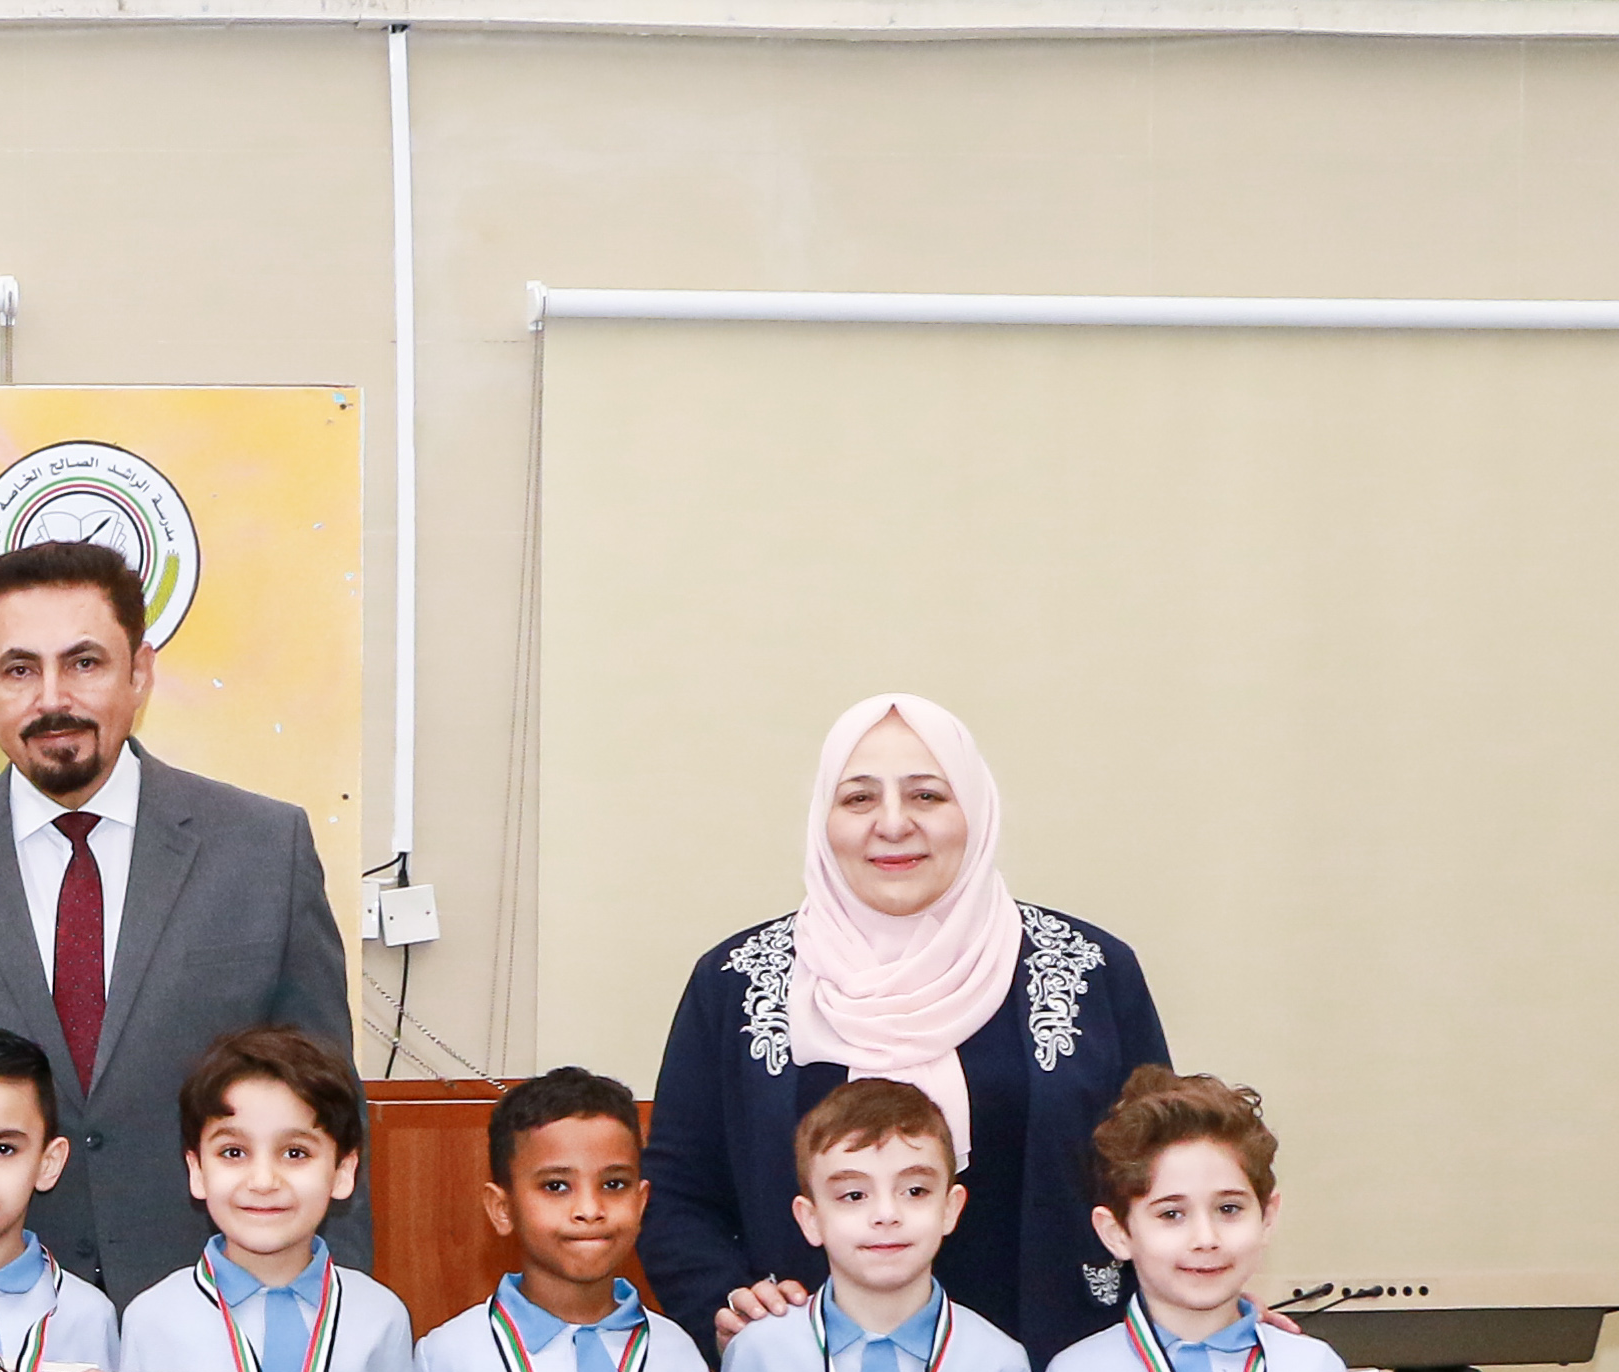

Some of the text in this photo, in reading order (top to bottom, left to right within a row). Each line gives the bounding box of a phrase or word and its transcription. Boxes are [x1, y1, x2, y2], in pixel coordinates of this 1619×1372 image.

[49, 456, 100, 476] الصالح
[107, 464, 151, 493] الراشد
[151, 493, 175, 543] مدرسة
